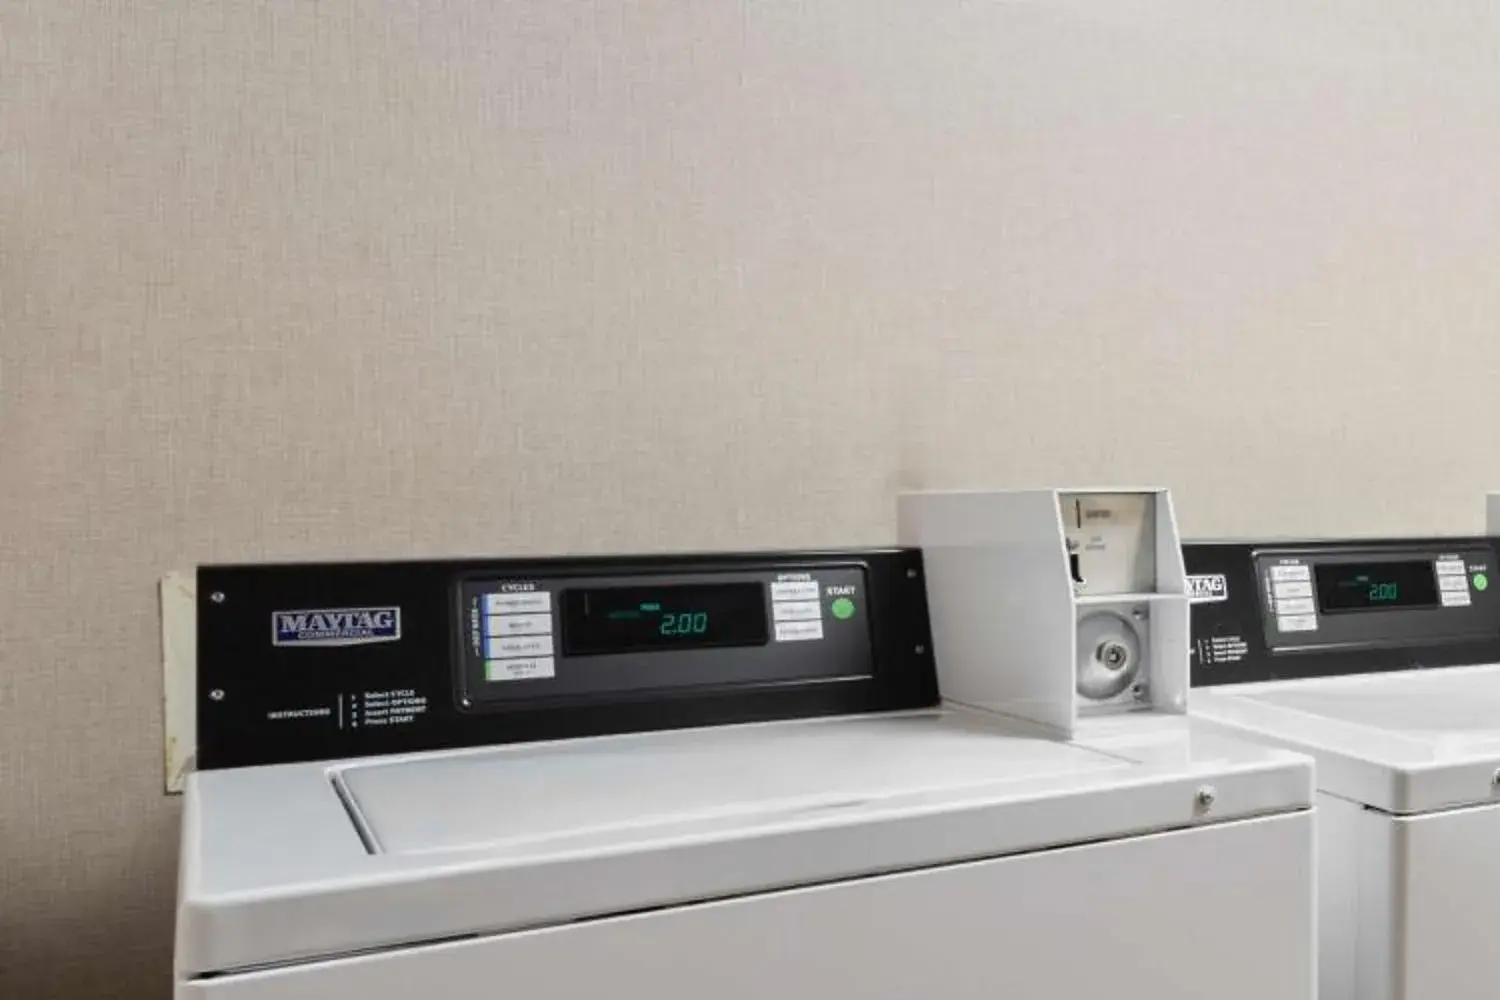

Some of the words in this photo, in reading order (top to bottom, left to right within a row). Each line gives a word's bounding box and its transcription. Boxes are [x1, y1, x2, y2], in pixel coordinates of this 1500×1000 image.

[501, 583, 535, 592] CYCLES
[826, 585, 855, 596] START
[280, 610, 394, 632] MAYTAG
[659, 611, 708, 635] 2.00
